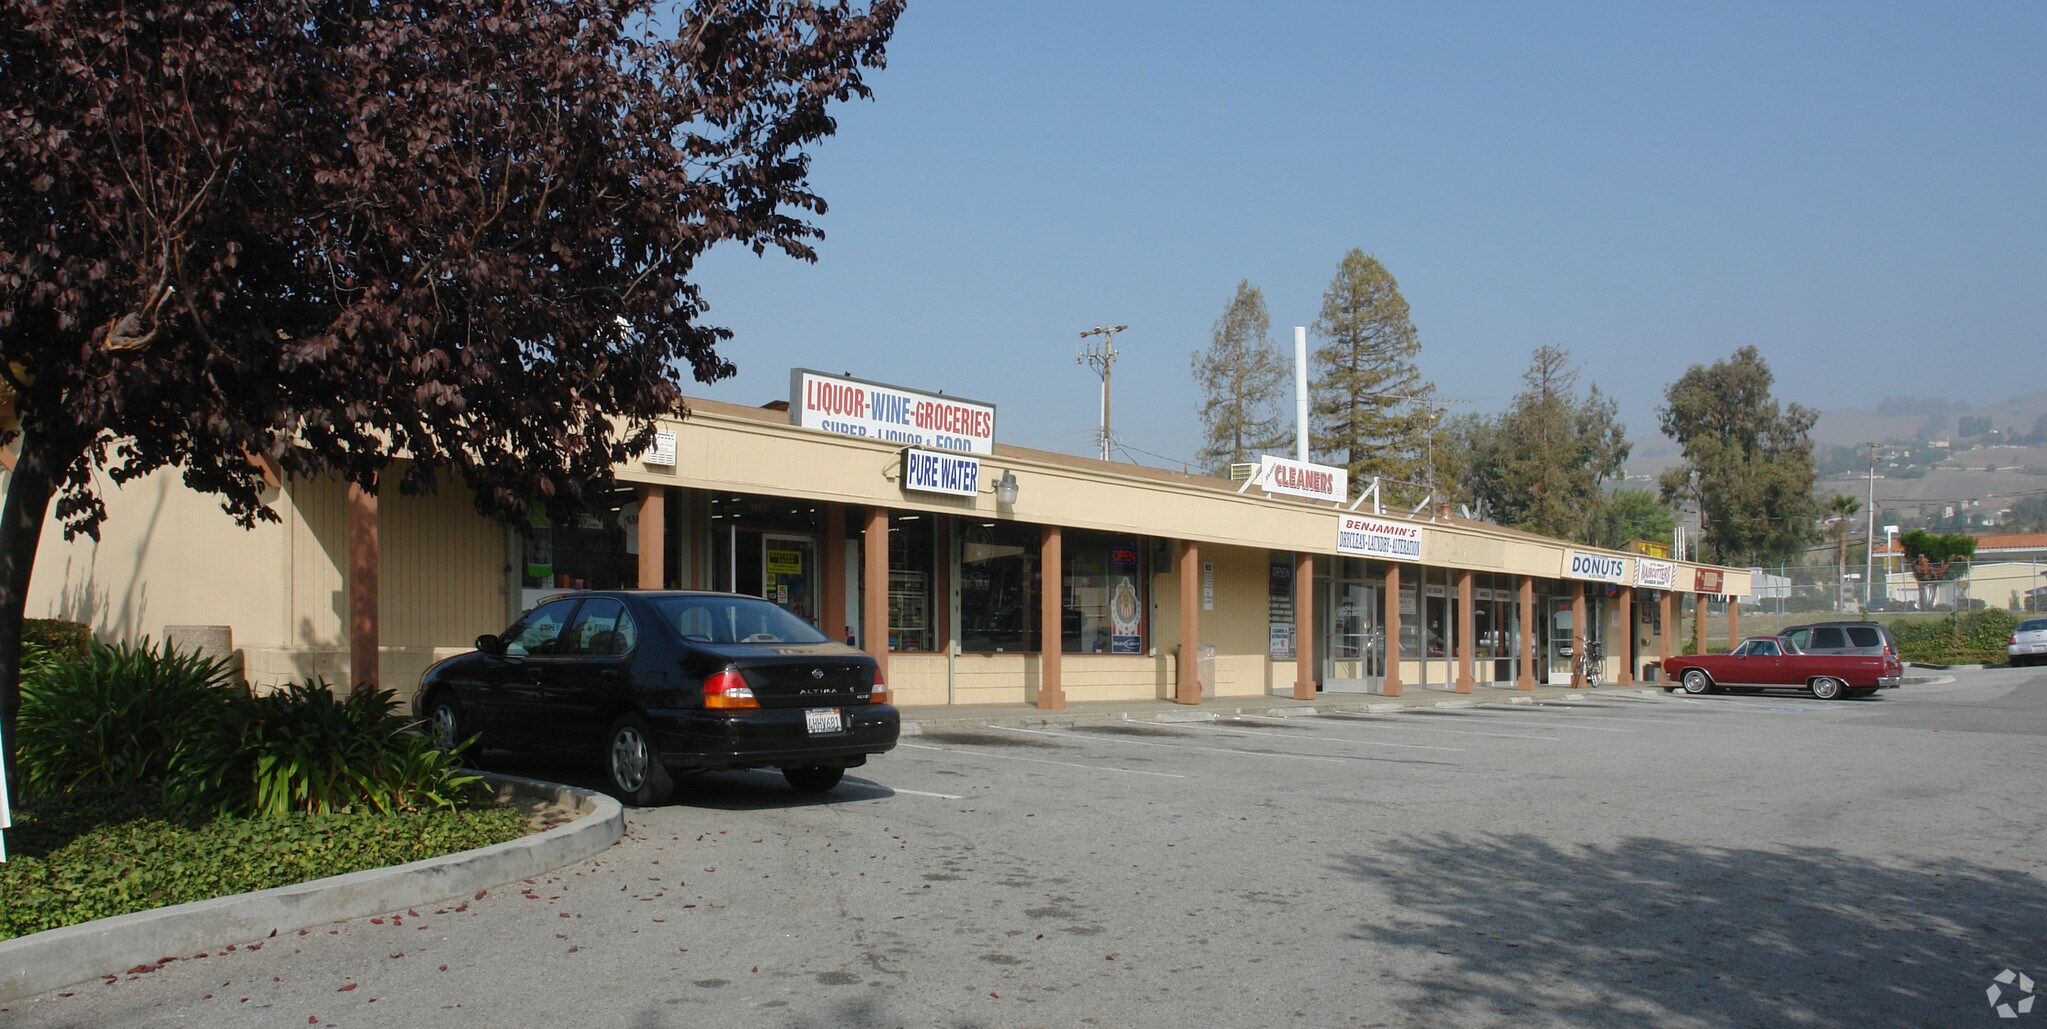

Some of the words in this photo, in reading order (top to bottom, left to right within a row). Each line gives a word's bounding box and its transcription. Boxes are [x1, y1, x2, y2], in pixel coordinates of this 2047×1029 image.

[909, 454, 938, 487] PURE
[941, 458, 977, 492] WATER
[1274, 464, 1333, 494] CLEANERS
[1346, 519, 1417, 537] BENJAMIN'S
[1113, 549, 1135, 562] OPEN
[1272, 566, 1290, 578] OPEN
[1572, 556, 1623, 576] DONUTS
